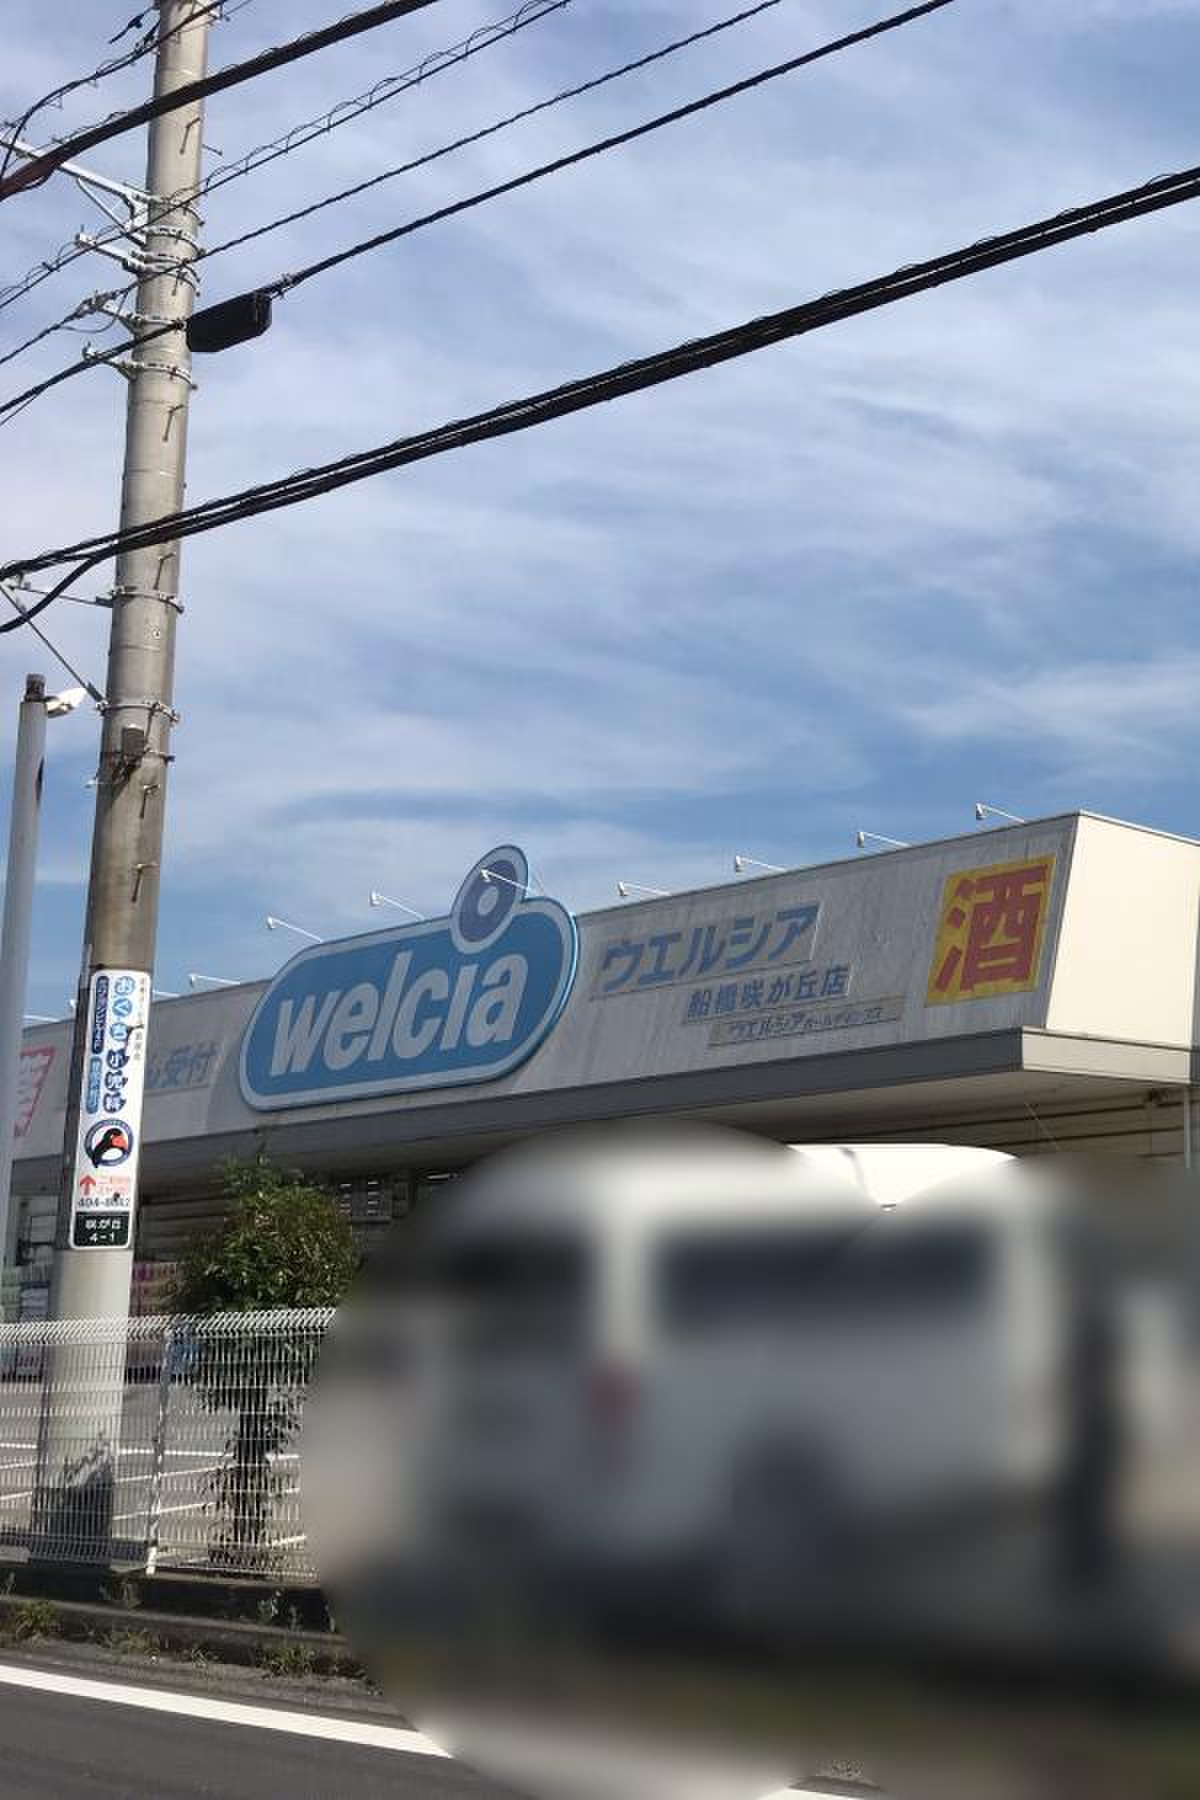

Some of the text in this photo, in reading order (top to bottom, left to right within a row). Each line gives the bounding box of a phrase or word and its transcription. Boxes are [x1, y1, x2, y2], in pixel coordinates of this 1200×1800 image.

[602, 903, 820, 992] ウエルシア
[935, 864, 1048, 993] 酒
[270, 949, 528, 1078] welcia
[687, 963, 849, 1022] 船橋咲が丘店
